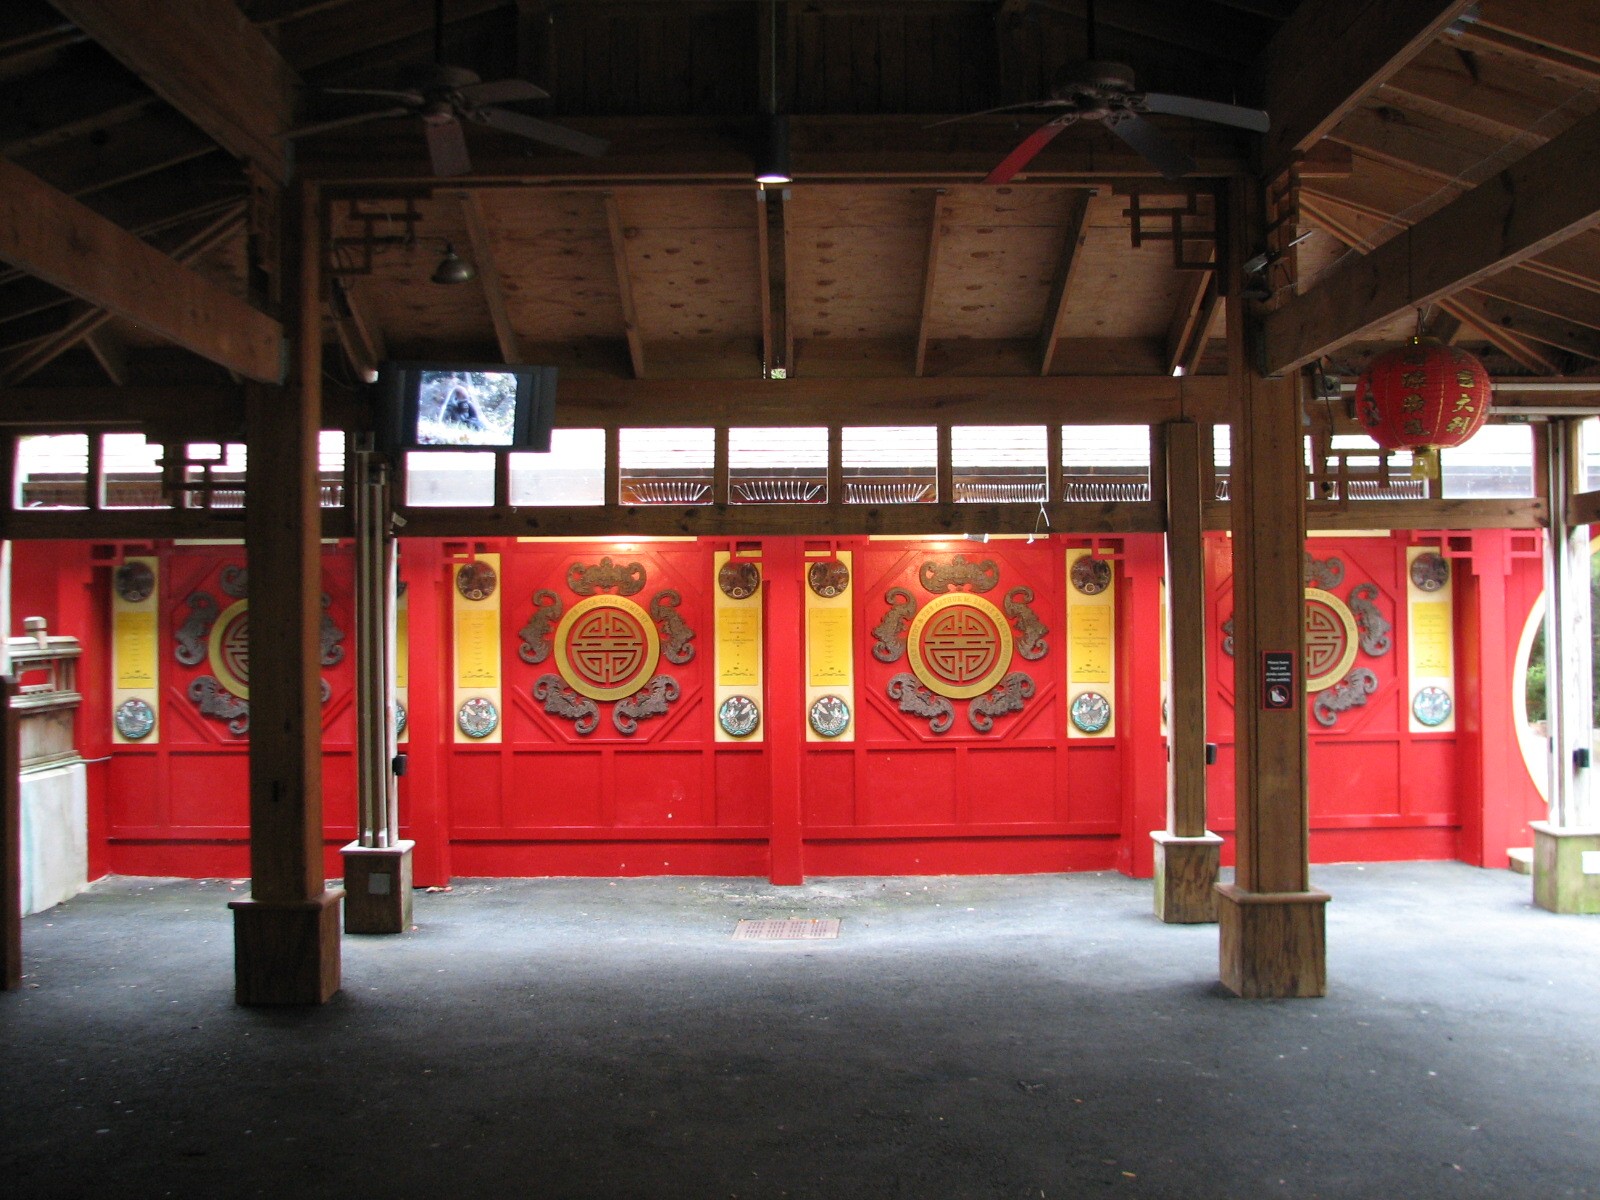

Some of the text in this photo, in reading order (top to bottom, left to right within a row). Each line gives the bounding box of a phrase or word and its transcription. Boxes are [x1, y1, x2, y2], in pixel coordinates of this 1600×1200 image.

[577, 597, 618, 612] COCA-COLA
[619, 599, 650, 624] COMPANY
[933, 595, 962, 608] ARTHUR
